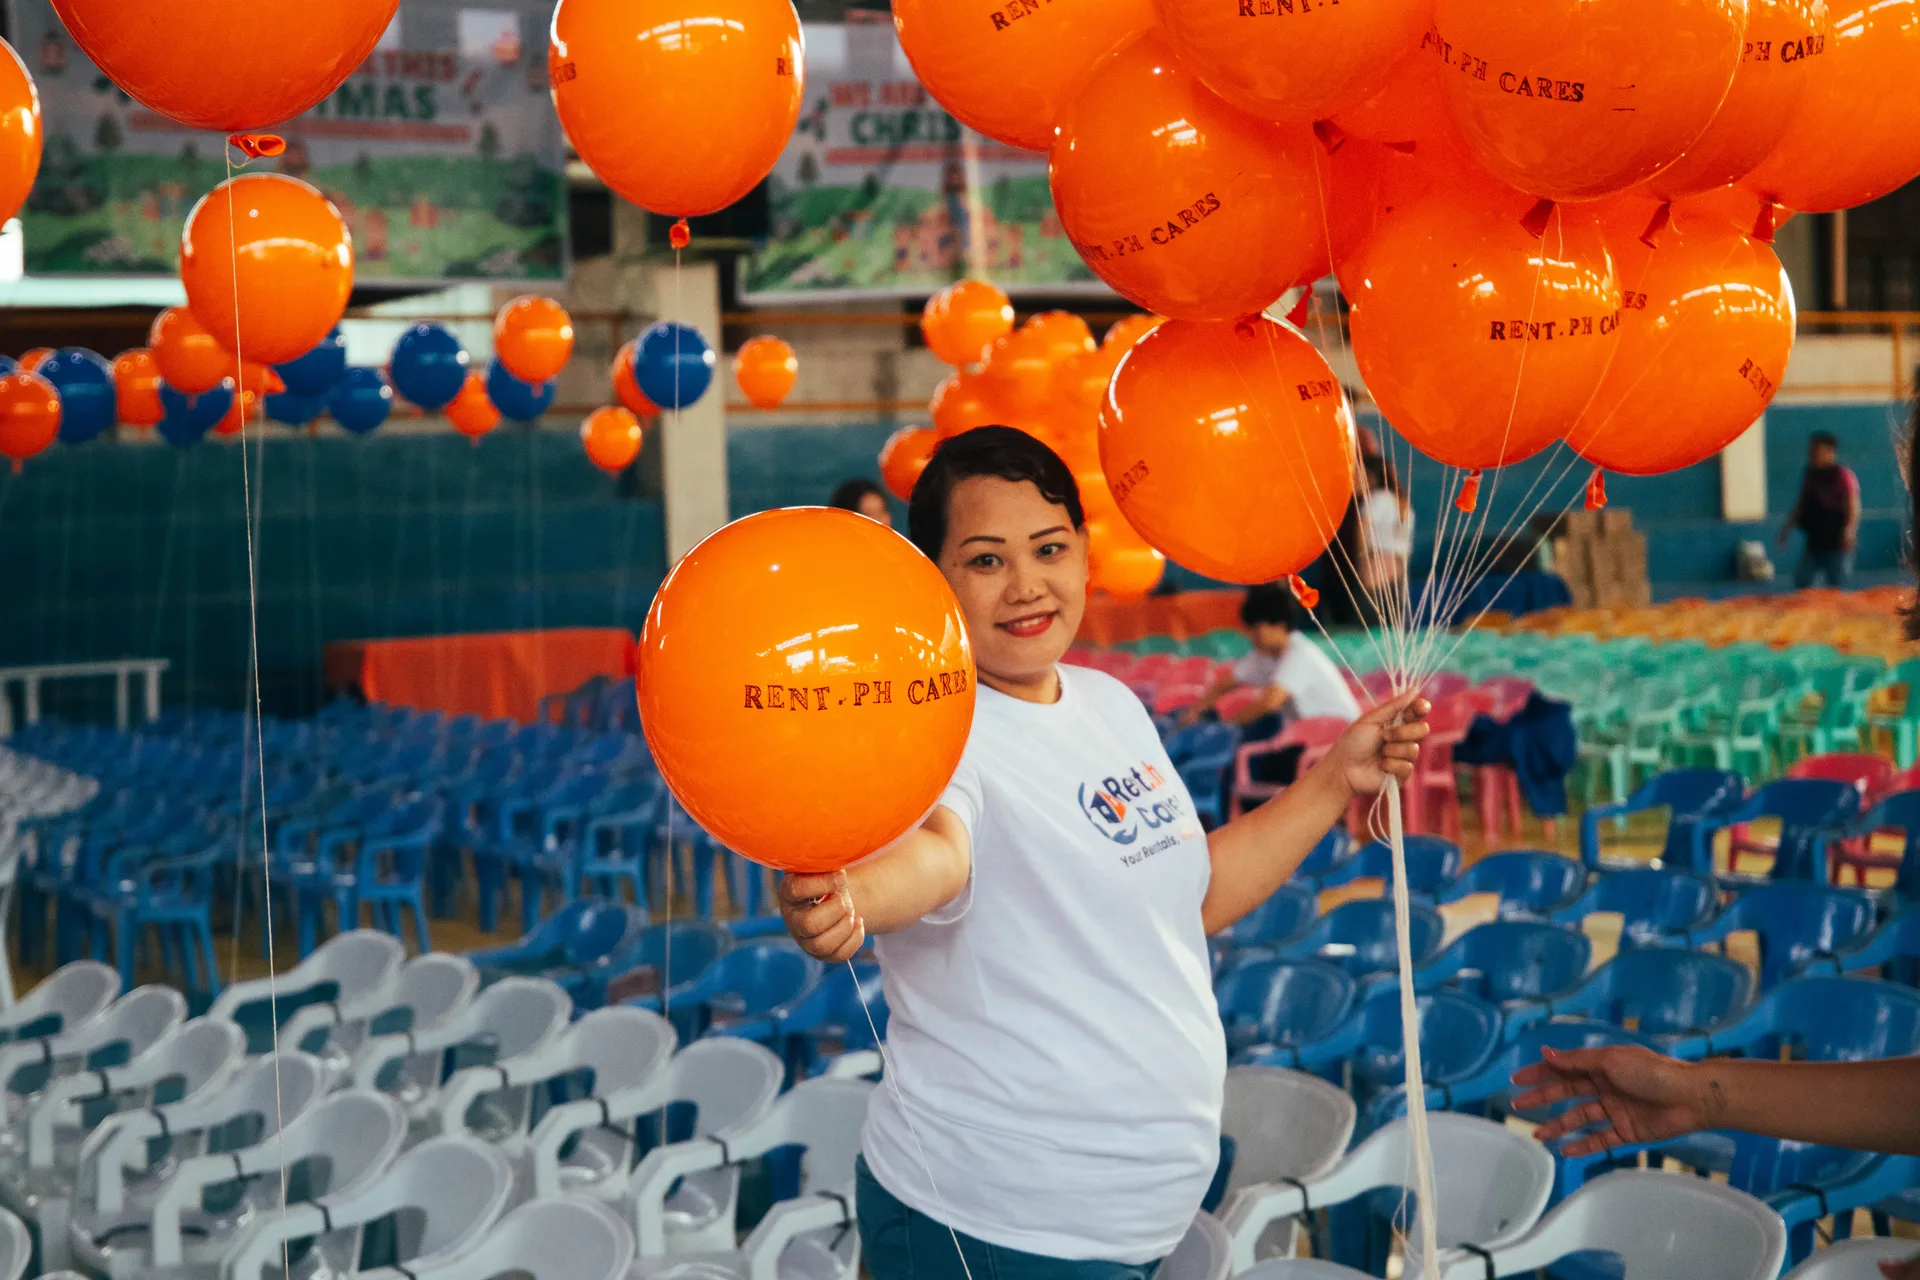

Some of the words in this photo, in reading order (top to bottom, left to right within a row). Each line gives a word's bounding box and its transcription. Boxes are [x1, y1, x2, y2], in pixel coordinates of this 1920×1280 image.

[1499, 72, 1585, 102] CARES
[1150, 192, 1221, 245] CARES
[908, 669, 967, 705] CARES
